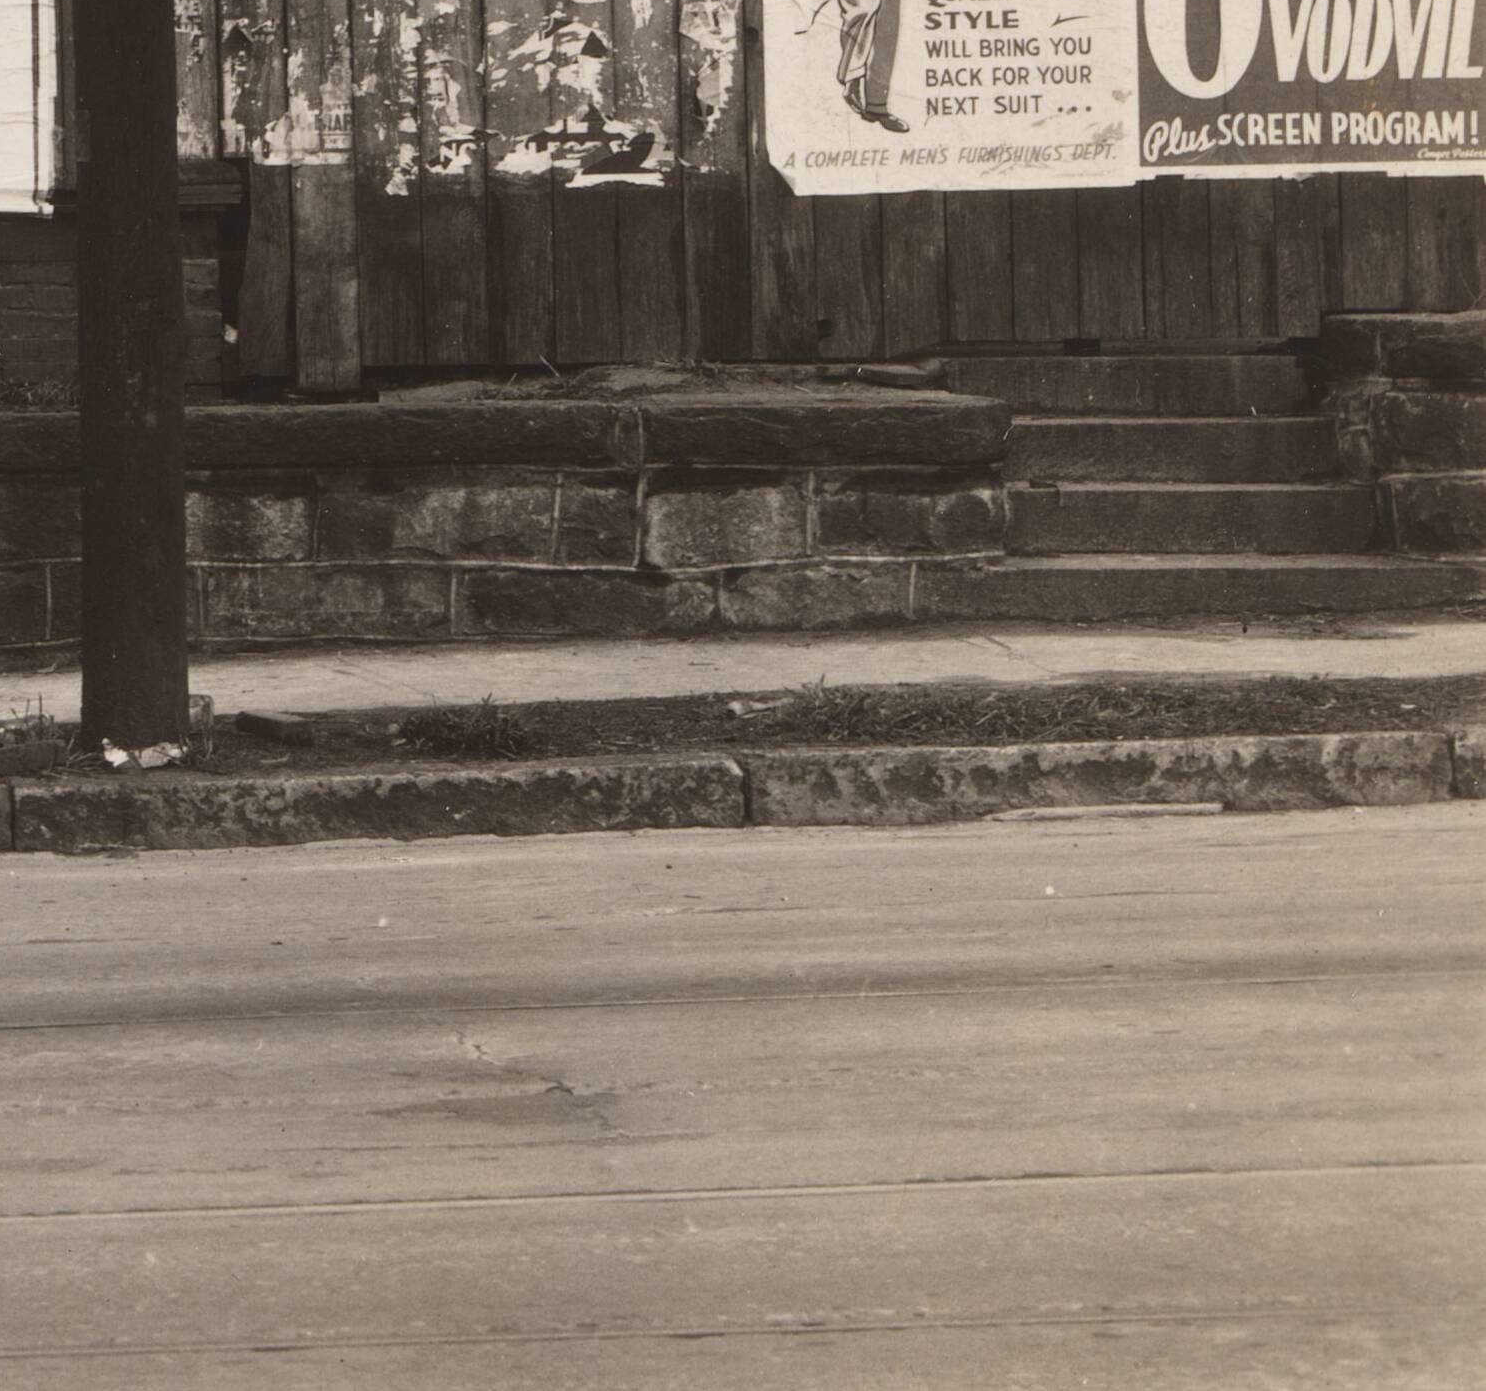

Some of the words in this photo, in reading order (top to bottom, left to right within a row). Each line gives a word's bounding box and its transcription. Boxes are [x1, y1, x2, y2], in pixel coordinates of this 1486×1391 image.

[923, 11, 1019, 30] STYLE
[926, 39, 971, 58] WILL
[980, 38, 1040, 58] BRING
[1050, 36, 1092, 55] YOU
[926, 68, 982, 88] BACK
[993, 67, 1029, 86] FOR
[1037, 66, 1092, 85] YOUR
[926, 96, 979, 116] NEXT
[994, 95, 1043, 114] SUIT
[1143, 118, 1217, 162] Plus
[1218, 113, 1321, 145] SCREEN
[784, 153, 796, 168] A
[805, 151, 889, 169] COMPLETE
[958, 144, 1062, 164] FURNISHINGS
